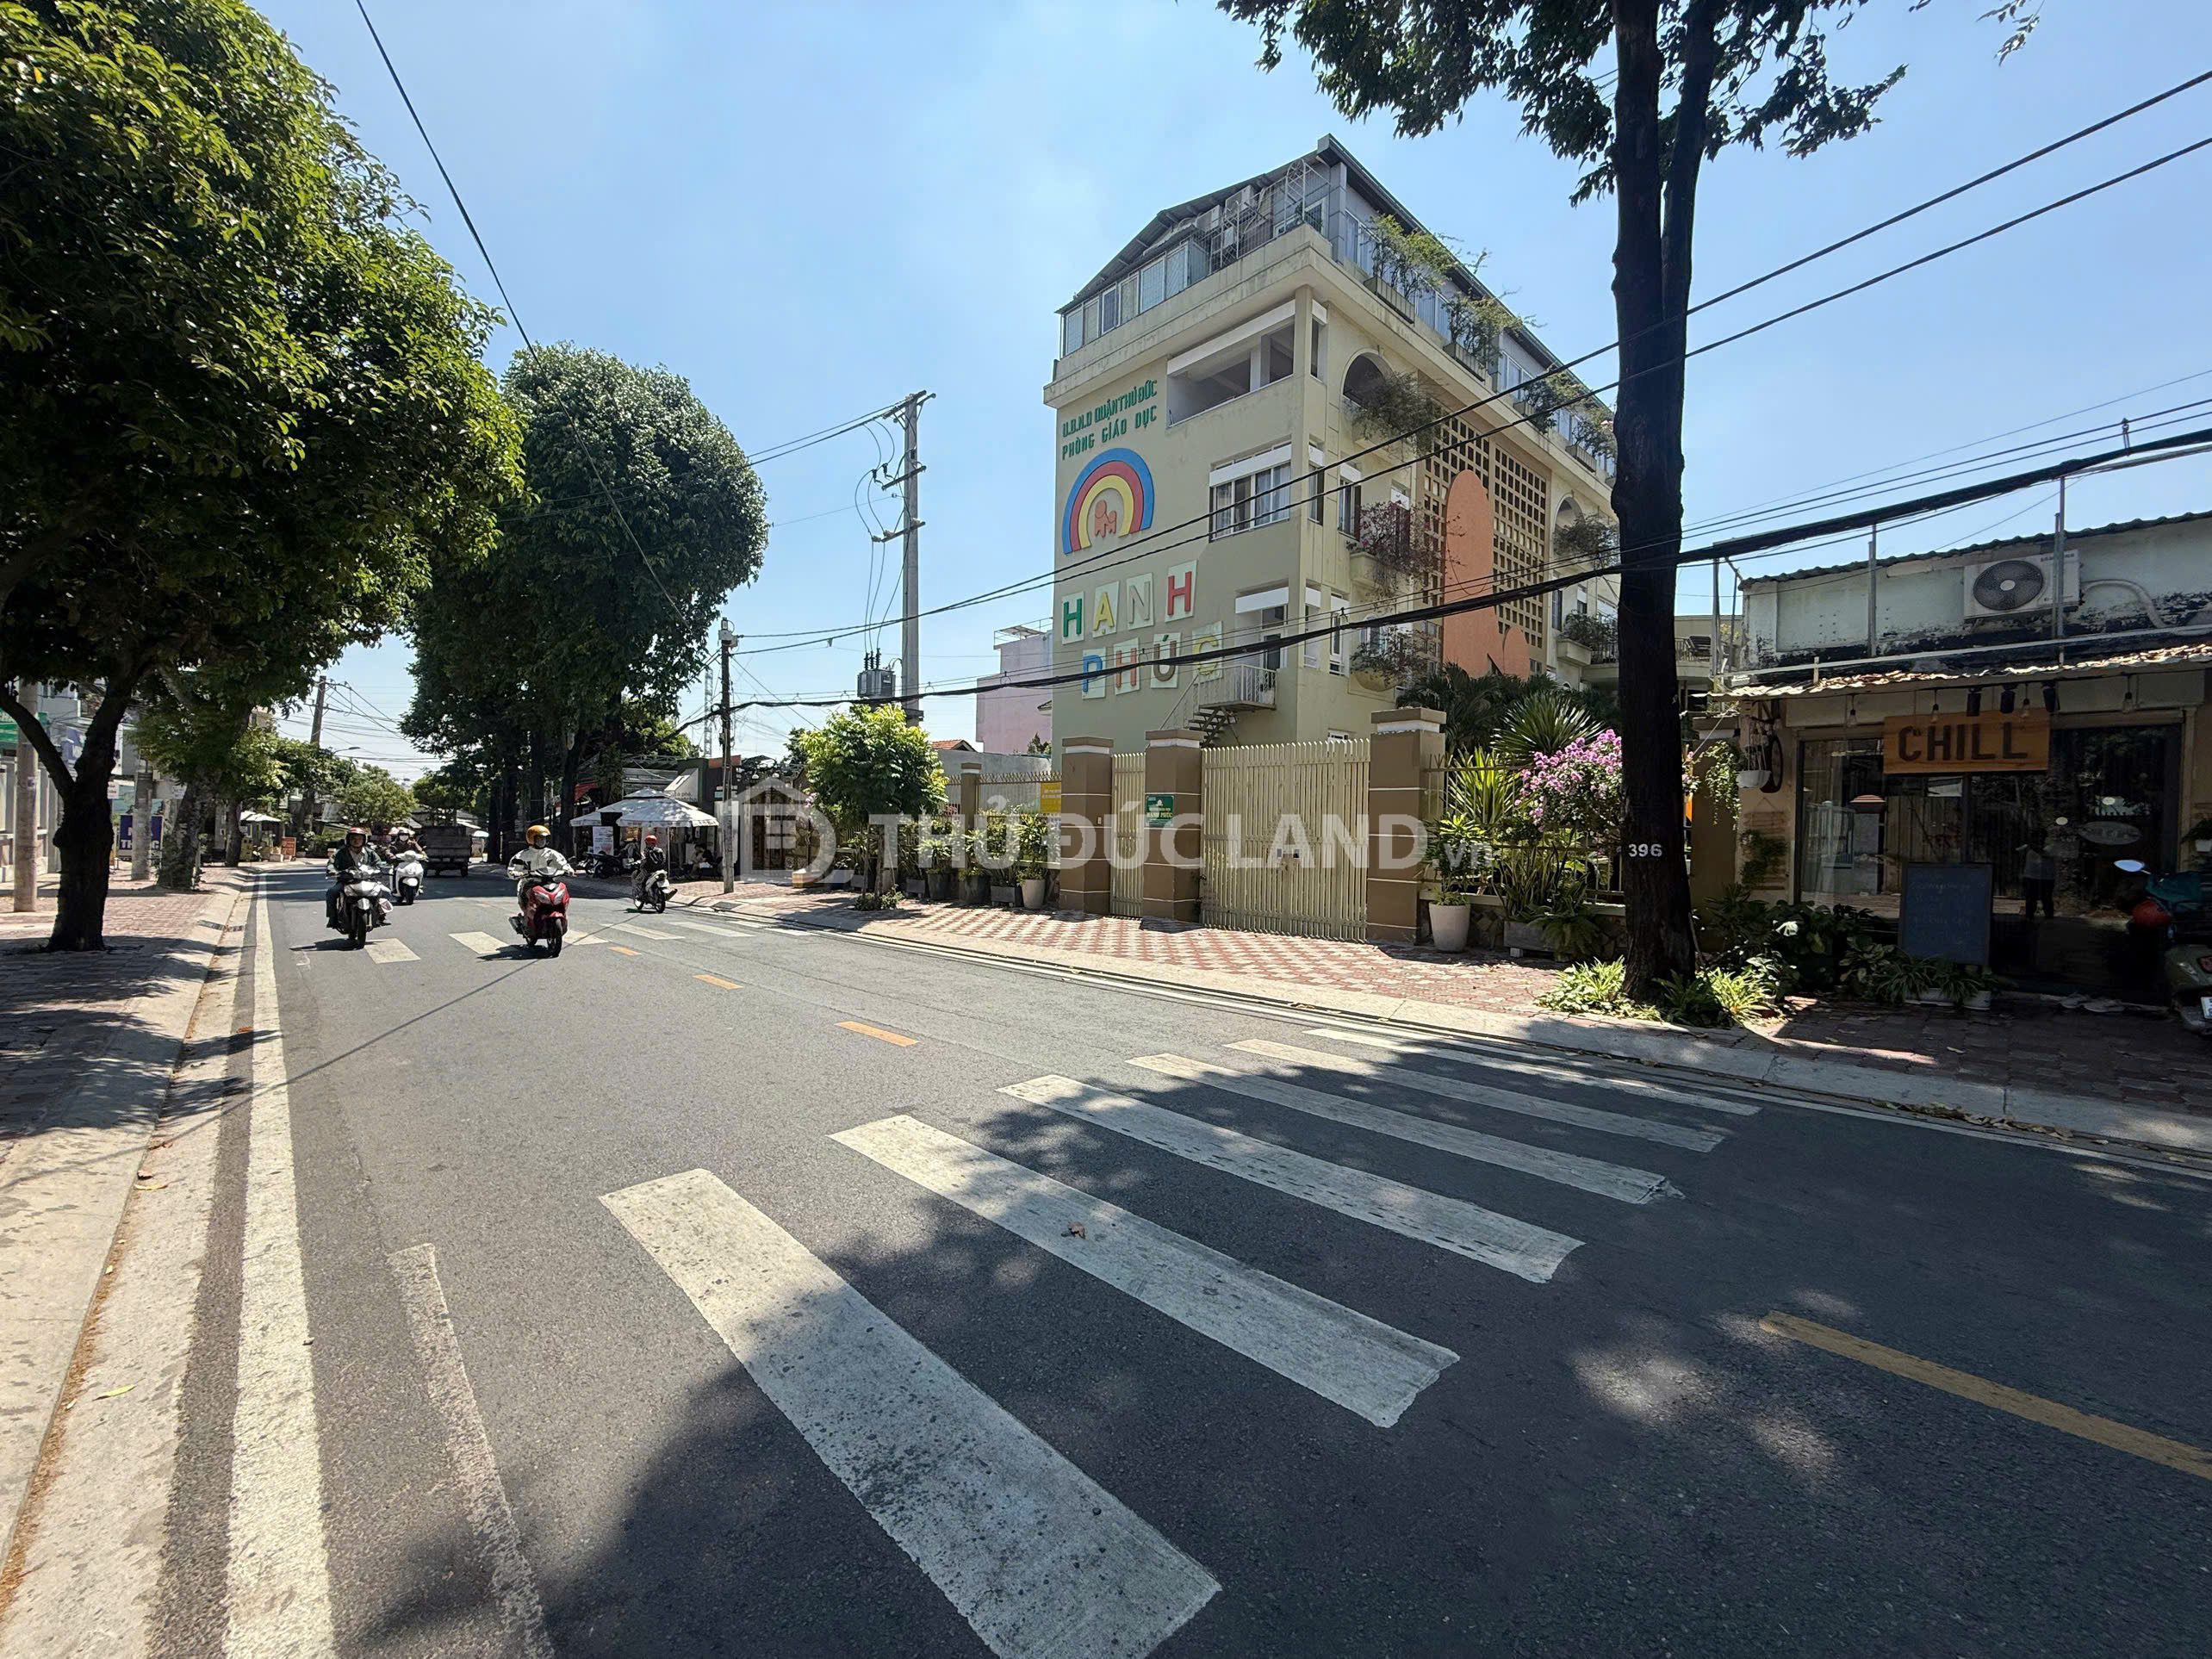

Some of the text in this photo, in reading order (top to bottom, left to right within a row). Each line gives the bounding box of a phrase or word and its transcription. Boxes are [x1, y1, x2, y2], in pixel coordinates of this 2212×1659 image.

[1062, 405, 1158, 461] PHÒNG GIÁO DỤC
[1063, 570, 1193, 640] HẠNH
[1898, 721, 2028, 761] CHILL
[1628, 843, 1662, 858] 396
